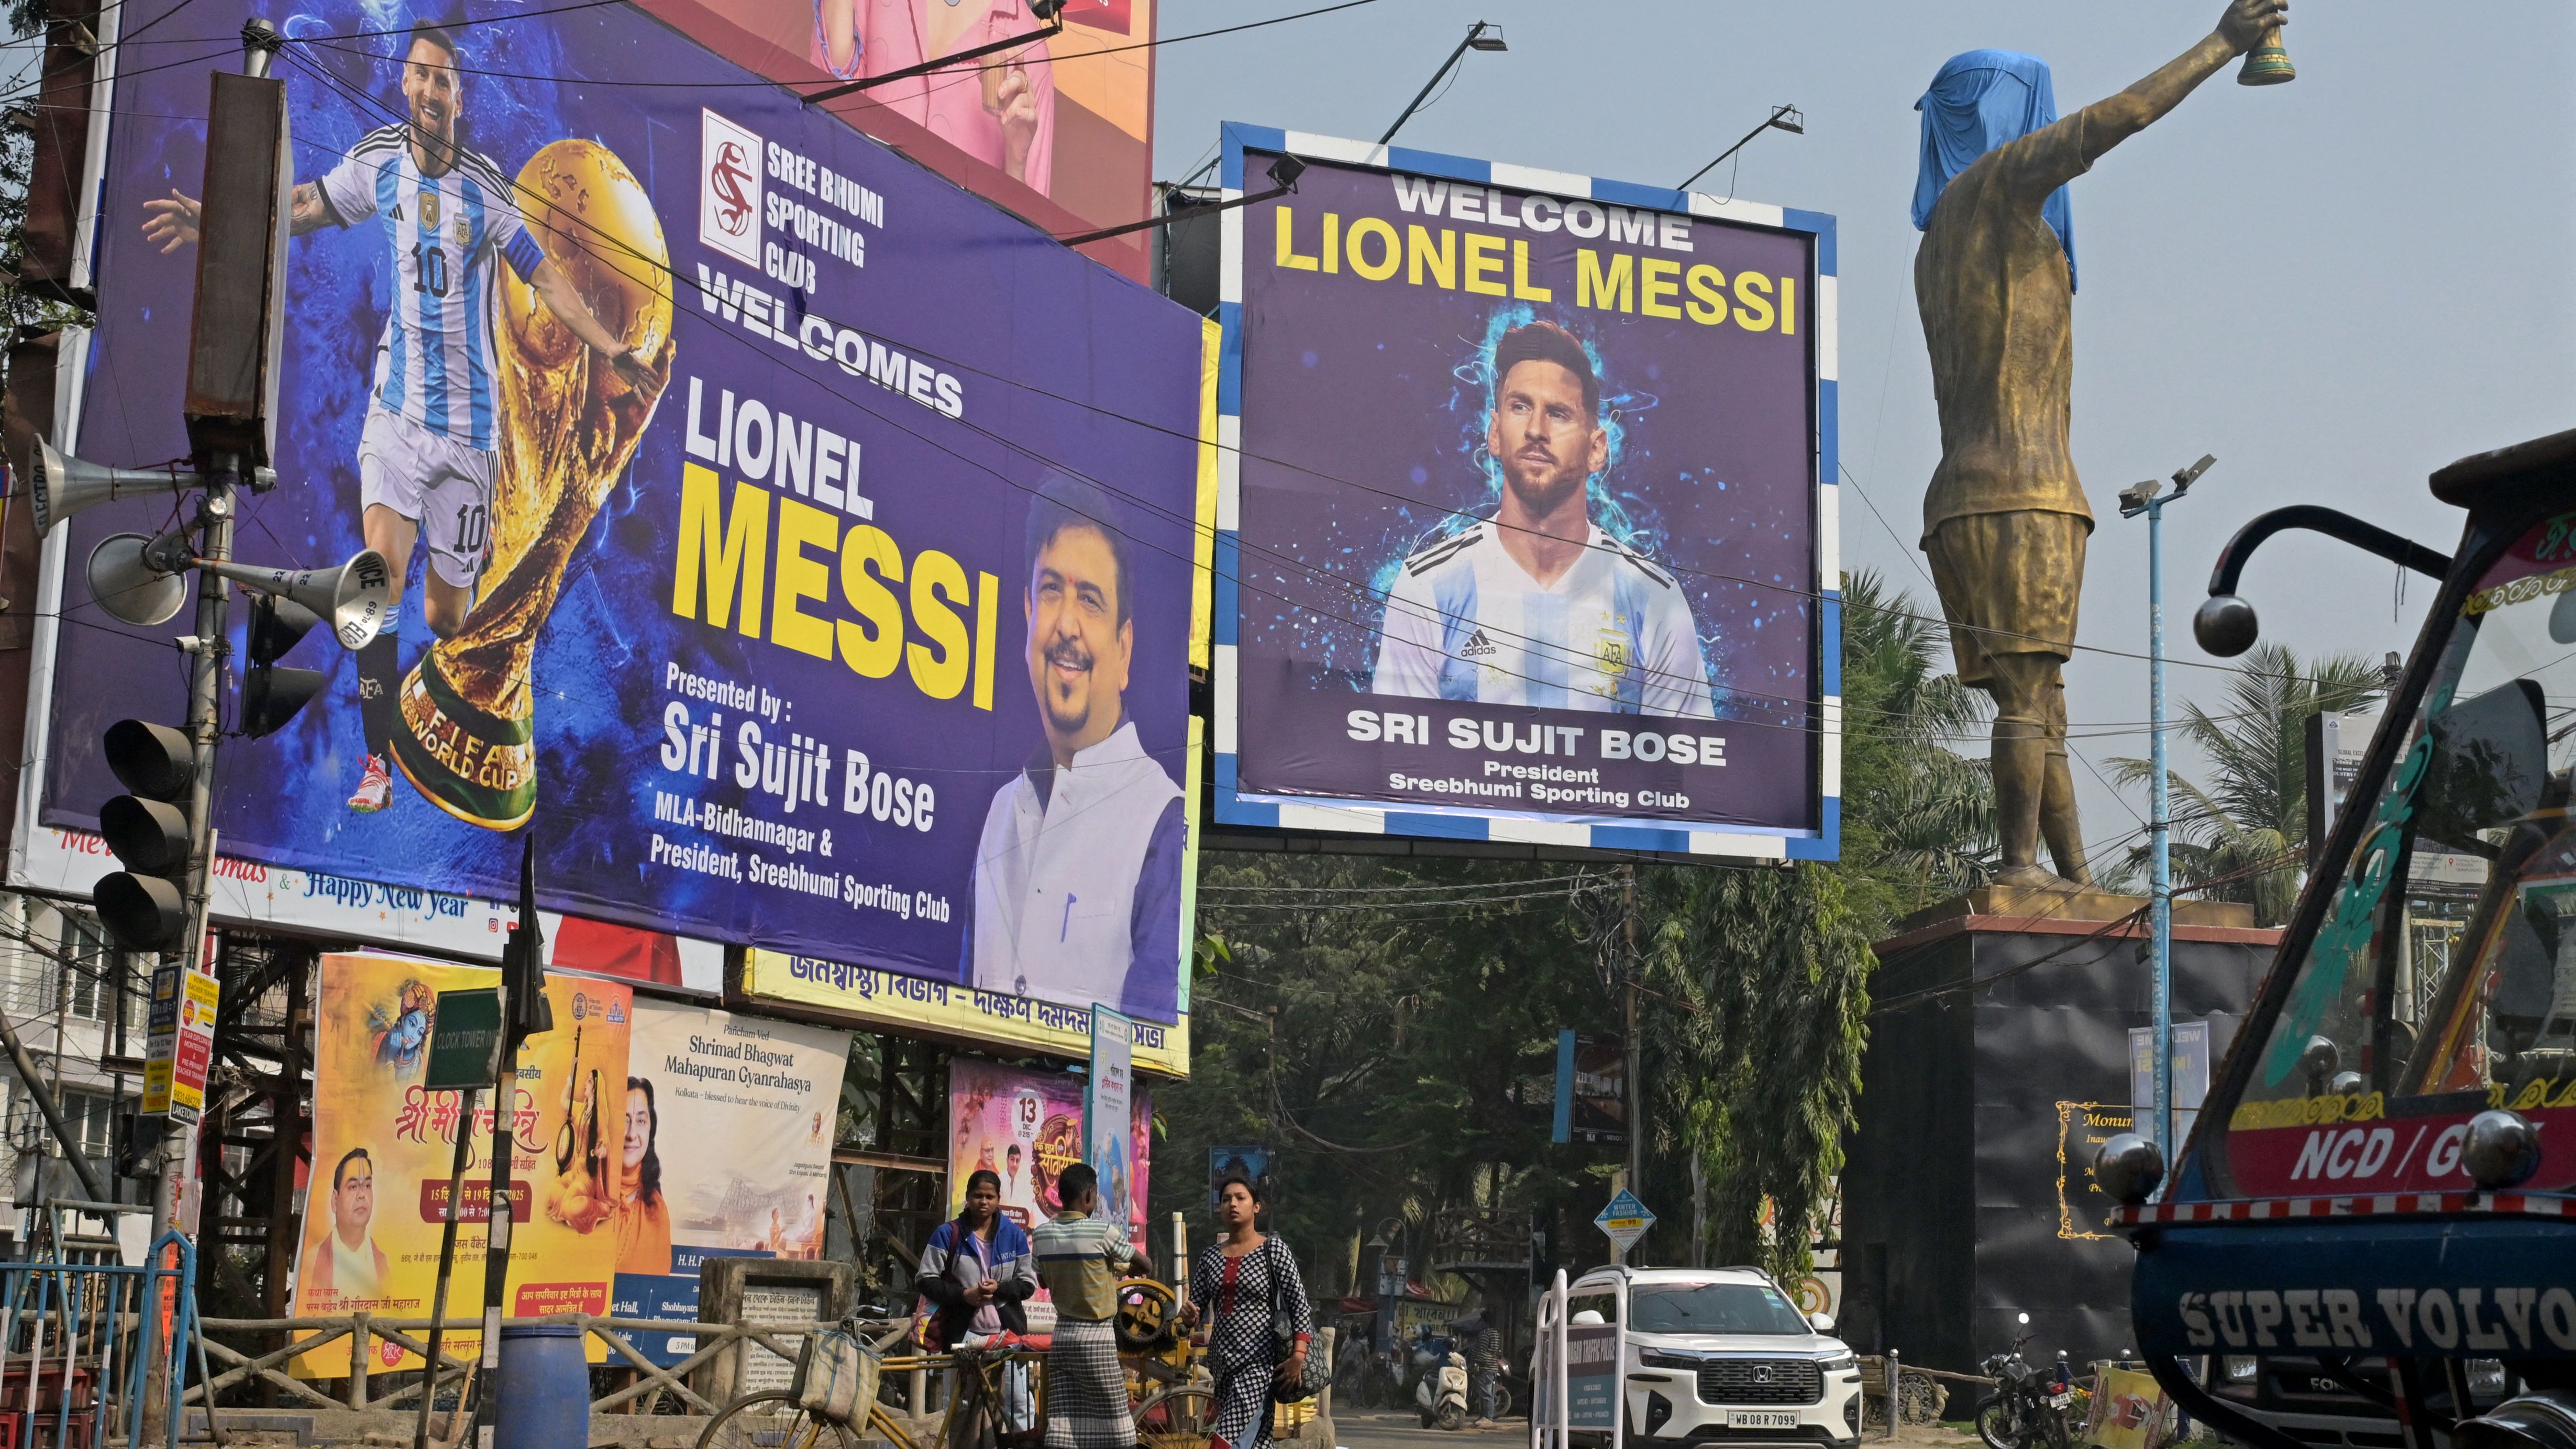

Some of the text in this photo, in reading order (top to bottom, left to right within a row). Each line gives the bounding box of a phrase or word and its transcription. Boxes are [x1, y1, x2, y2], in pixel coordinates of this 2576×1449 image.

[767, 141, 883, 229] SREE BHUMI
[766, 191, 864, 268] SPORTING
[1391, 173, 1694, 252] WELCOME
[411, 241, 449, 298] 10
[765, 241, 816, 294] CLUB
[1276, 205, 1795, 335] LIONEL MESSI
[697, 262, 963, 419] WELCOMES
[685, 375, 874, 521] LIONEL
[453, 503, 486, 554] 10
[672, 460, 999, 712] MESSI
[1460, 645, 1497, 657] adidas
[359, 676, 384, 699] AFA
[666, 661, 756, 712] Presented
[761, 687, 782, 724] by
[411, 714, 474, 779] WORLD
[428, 707, 501, 766] FIFA
[1346, 709, 1727, 767] SRI SUJIT BOSE
[479, 766, 519, 790] CUP
[660, 700, 934, 833] Sri Sujit Bose
[1389, 772, 1690, 809] Sreebhumi Sporting Club
[1484, 760, 1599, 784] President
[655, 791, 833, 858] MLA-Bidhannagar &
[279, 871, 469, 920] & Happy New Year
[650, 833, 950, 923] President, Sreebhumi Sporting Club
[437, 1030, 486, 1049] CLOCK TOWER
[689, 1034, 794, 1067] Shrimad Bhagwat
[757, 1029, 770, 1041] Ved
[664, 1055, 811, 1096] Mahapuran Gyanrahasya
[675, 1086, 802, 1113] Kolkata blessed to hear the voice of Divinity
[172, 1103, 200, 1122] LAKETOWN
[1019, 1097, 1037, 1123] 13
[2290, 1127, 2395, 1180] NCD
[430, 1188, 439, 1201] 15
[473, 1189, 481, 1201] 19
[508, 1189, 524, 1201] 2025
[678, 1254, 687, 1266] H.
[688, 1255, 697, 1267] H.
[380, 1295, 391, 1310] जी
[392, 1298, 421, 1313] महाराज
[620, 1301, 639, 1314] Hall,
[2179, 1287, 2576, 1351] SUPER VOLVO
[675, 1342, 680, 1350] 5
[1583, 1336, 1616, 1364] TRAFFIC POLICE
[1735, 1414, 1795, 1425] WB 08 R 7099
